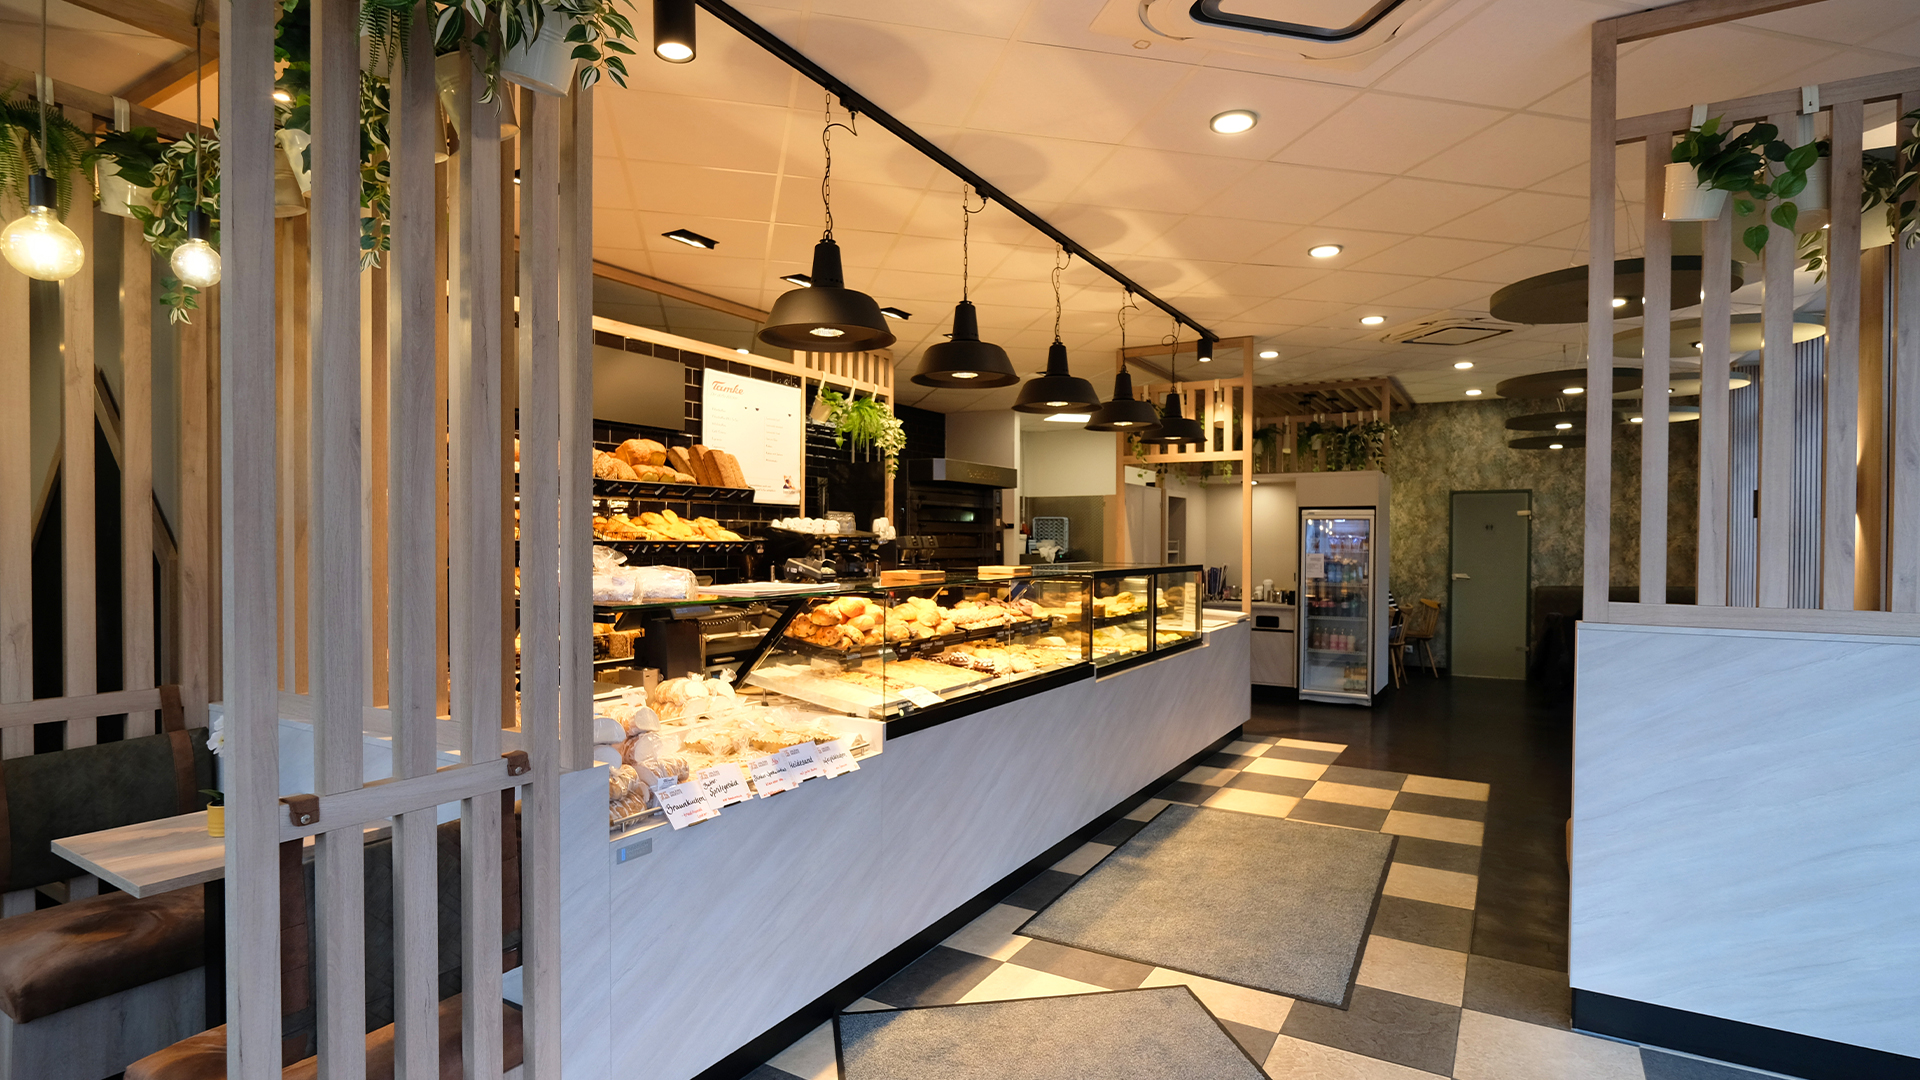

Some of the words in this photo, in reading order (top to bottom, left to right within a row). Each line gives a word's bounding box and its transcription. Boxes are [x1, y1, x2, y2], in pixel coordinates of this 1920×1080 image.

[711, 380, 744, 395] Tamke
[698, 771, 709, 781] 75
[658, 791, 670, 801] 75
